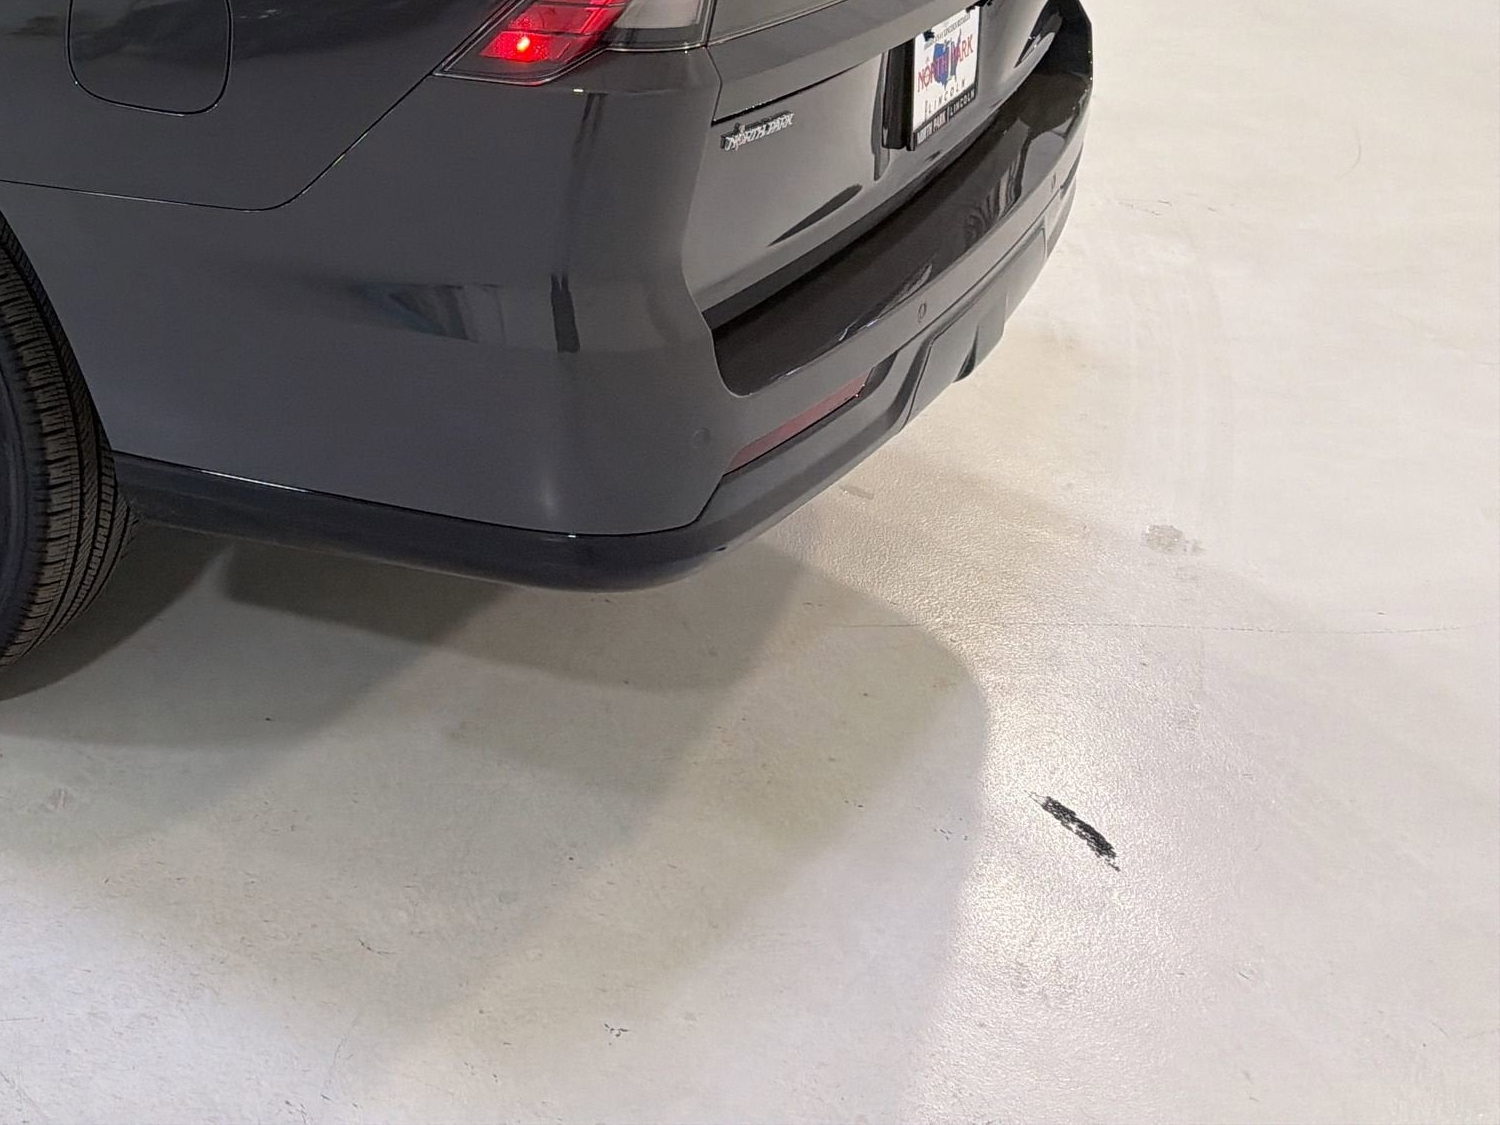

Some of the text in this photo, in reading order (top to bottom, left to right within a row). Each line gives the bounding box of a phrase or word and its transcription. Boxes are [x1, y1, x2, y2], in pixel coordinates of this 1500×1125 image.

[928, 78, 966, 115] LINCOLN
[948, 89, 976, 120] LINCOLN
[724, 113, 795, 151] NORTH PARK
